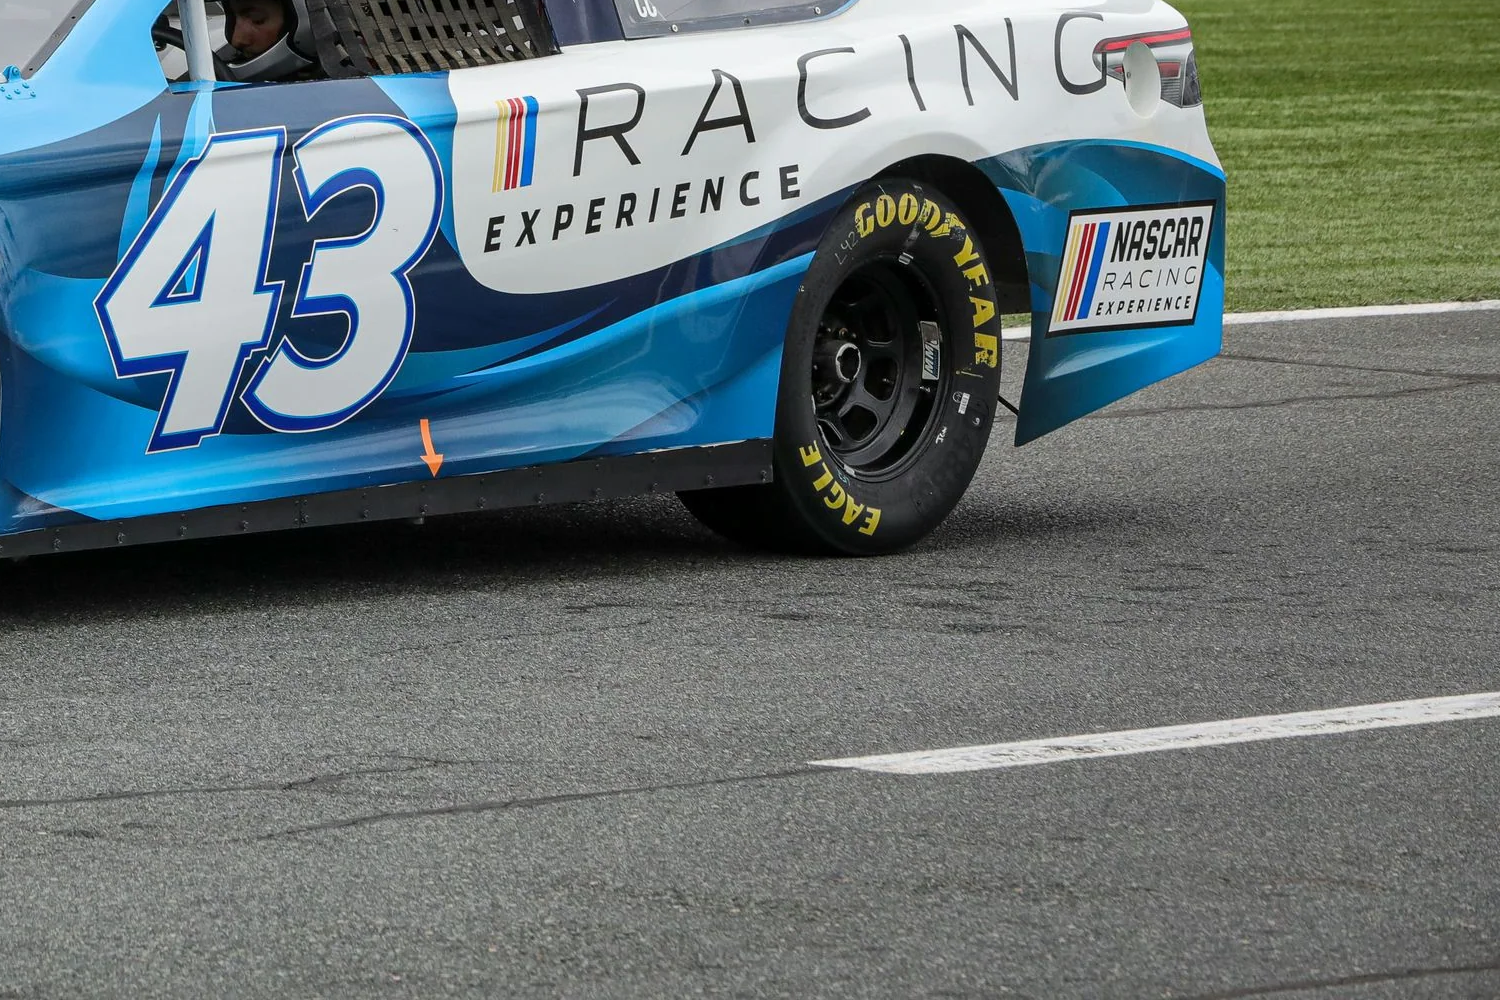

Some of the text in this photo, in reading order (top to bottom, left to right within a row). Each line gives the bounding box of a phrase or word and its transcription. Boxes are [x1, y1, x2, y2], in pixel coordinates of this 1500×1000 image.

[572, 11, 1108, 177] RACING
[483, 163, 801, 254] EXPERIENCE
[1109, 215, 1204, 264] NASCAR
[93, 113, 444, 454] 43
[1095, 295, 1192, 316] EXPERIENCE
[1102, 265, 1198, 292] RACING
[799, 440, 881, 536] EAGLE
